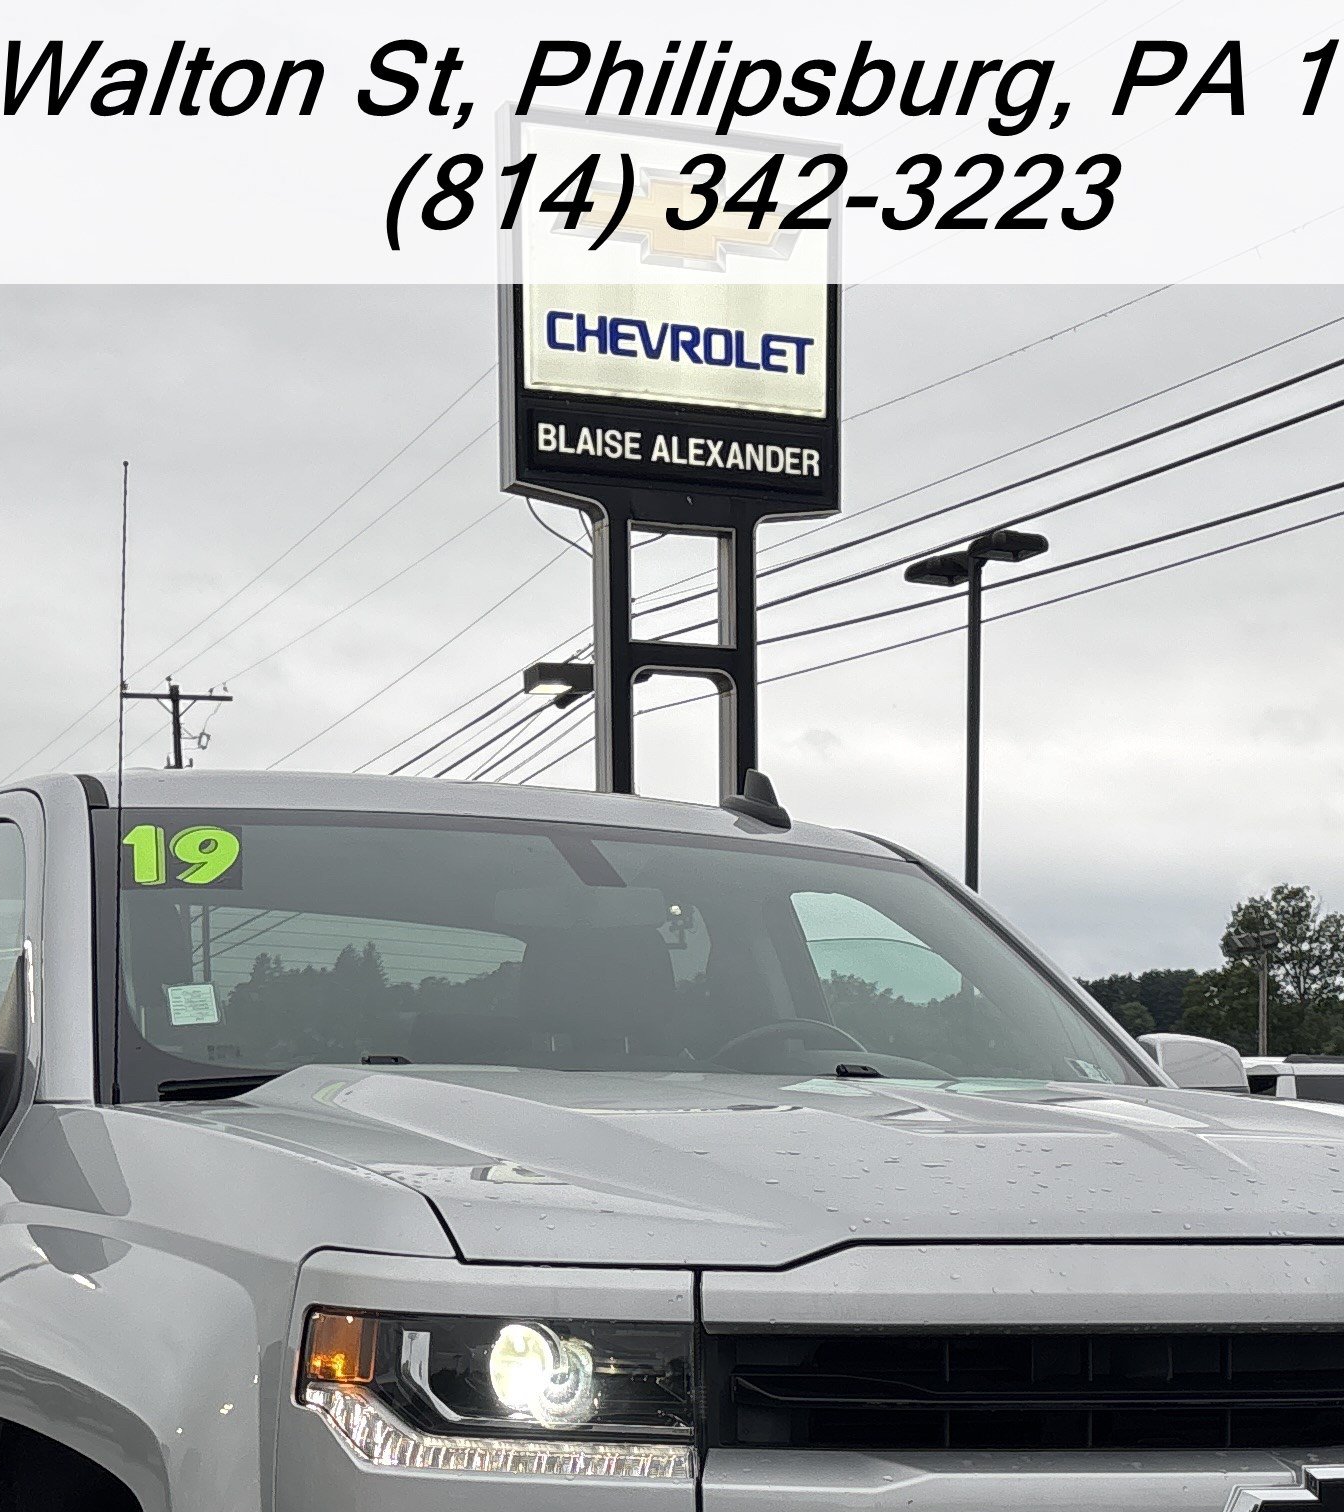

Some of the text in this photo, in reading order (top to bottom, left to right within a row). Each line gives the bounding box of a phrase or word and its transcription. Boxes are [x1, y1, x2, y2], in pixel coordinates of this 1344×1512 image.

[545, 309, 816, 376] CHEVROLET
[536, 421, 821, 477] BLAISE ALEXANDER
[122, 825, 240, 886] 19
